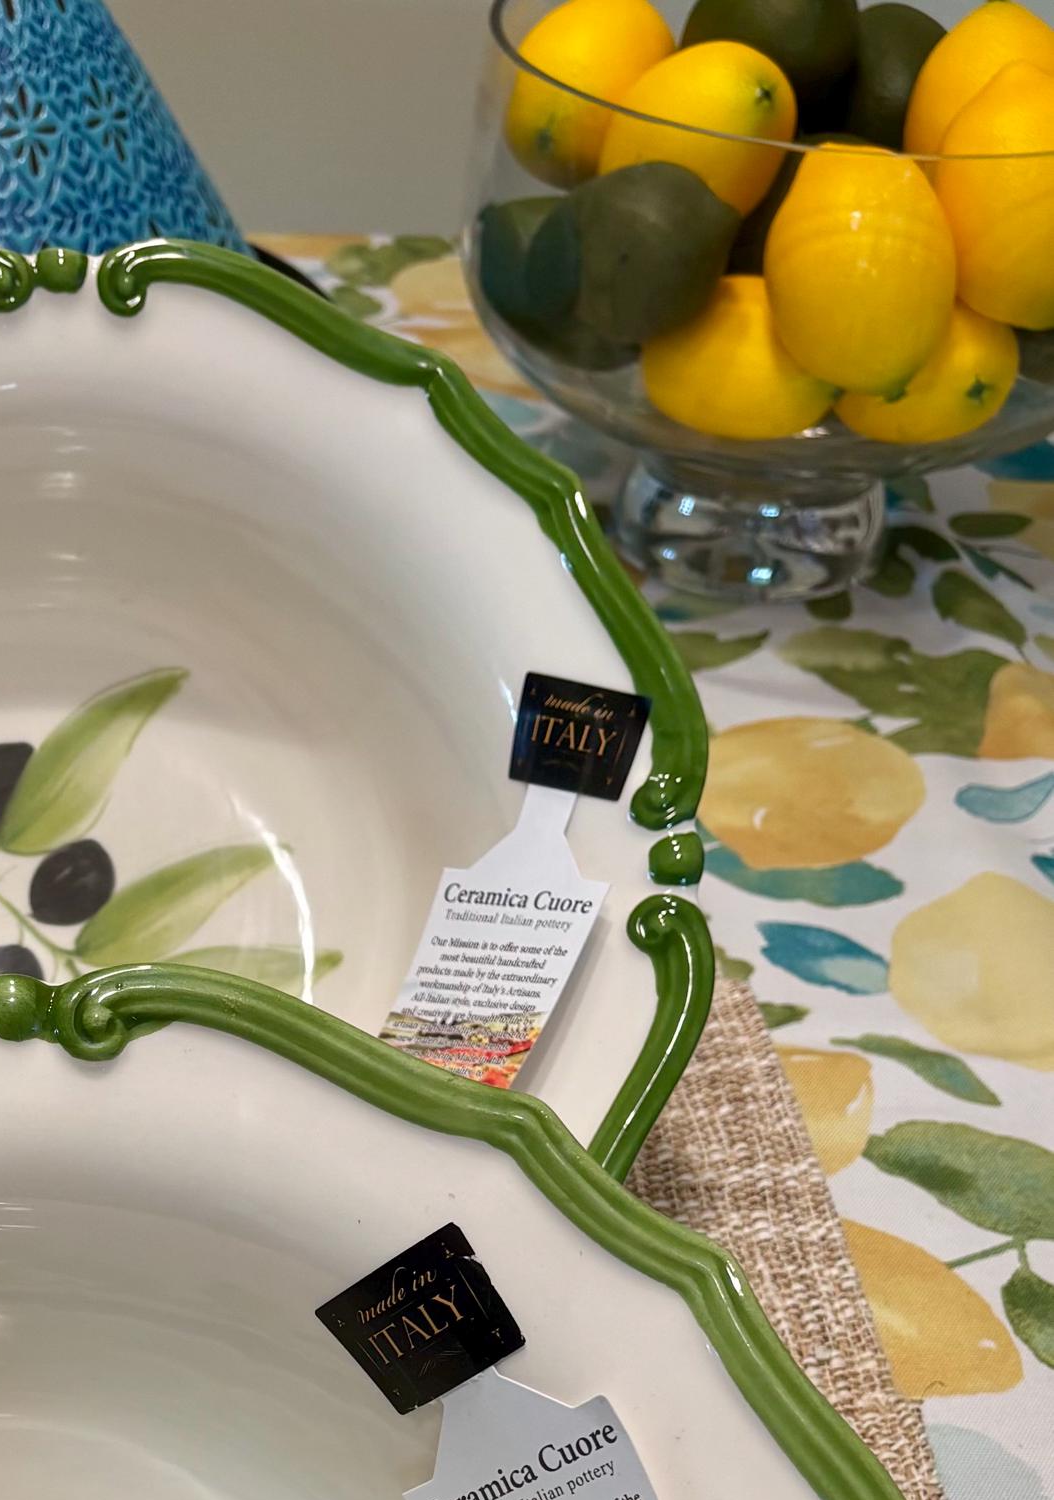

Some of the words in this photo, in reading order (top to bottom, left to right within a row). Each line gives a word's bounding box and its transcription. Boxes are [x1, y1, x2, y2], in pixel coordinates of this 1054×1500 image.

[544, 692, 604, 714] made
[594, 704, 614, 720] in
[531, 714, 617, 756] ITALY
[444, 882, 529, 909] Ceramica
[534, 890, 593, 914] Cuore
[445, 909, 497, 924] Traditional
[501, 913, 533, 926] Italian
[534, 919, 572, 932] pottery
[431, 936, 447, 946] Our
[449, 938, 479, 948] Mission
[499, 943, 518, 953] offer
[519, 945, 542, 954] some
[543, 946, 555, 956] of
[555, 948, 568, 957] the
[440, 954, 459, 962] most
[461, 954, 496, 965] beautiful
[497, 958, 546, 970] handcrafted
[417, 966, 451, 976] products
[453, 968, 474, 977] made
[476, 970, 486, 980] by
[487, 970, 500, 980] the
[501, 973, 558, 987] extraordinary
[419, 980, 471, 994] workmanship
[471, 984, 482, 993] of
[482, 984, 506, 996] Italy's
[473, 999, 508, 1010] exclusive
[510, 1000, 535, 1012] design
[355, 1267, 407, 1324] made
[412, 1269, 436, 1291] in
[368, 1284, 464, 1364] ITALY
[538, 1425, 617, 1472] Cuore
[567, 1460, 615, 1494] pottery
